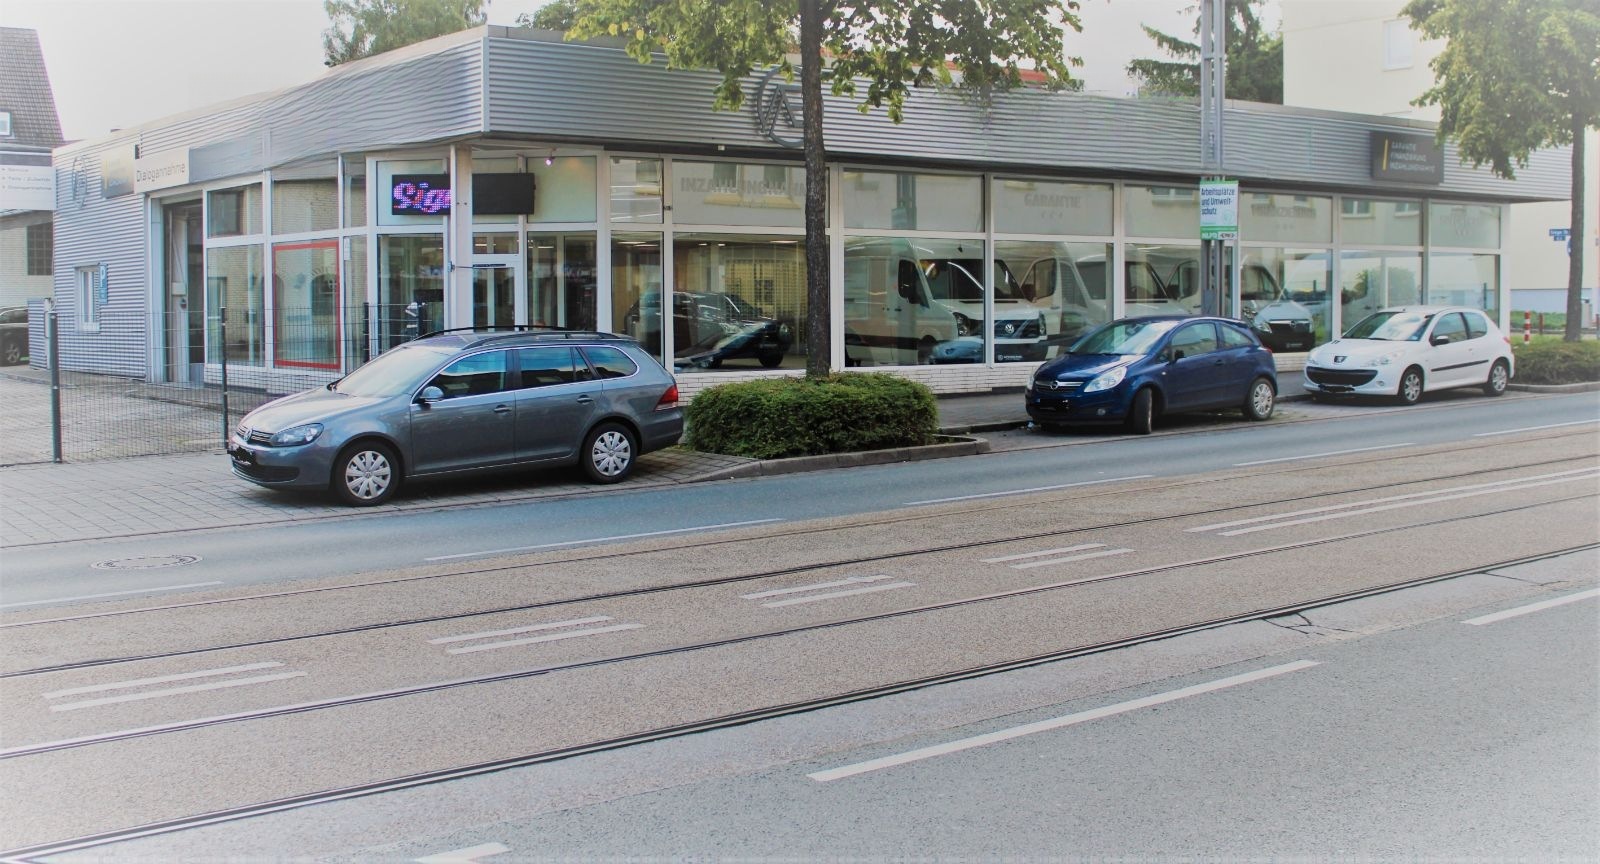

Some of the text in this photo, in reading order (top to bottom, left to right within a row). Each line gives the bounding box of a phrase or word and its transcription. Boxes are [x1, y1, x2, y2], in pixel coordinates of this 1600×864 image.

[136, 163, 186, 183] Dialogannahme
[1201, 187, 1235, 197] Arbeitsplätze
[1201, 197, 1210, 206] und
[1201, 207, 1217, 215] schutz
